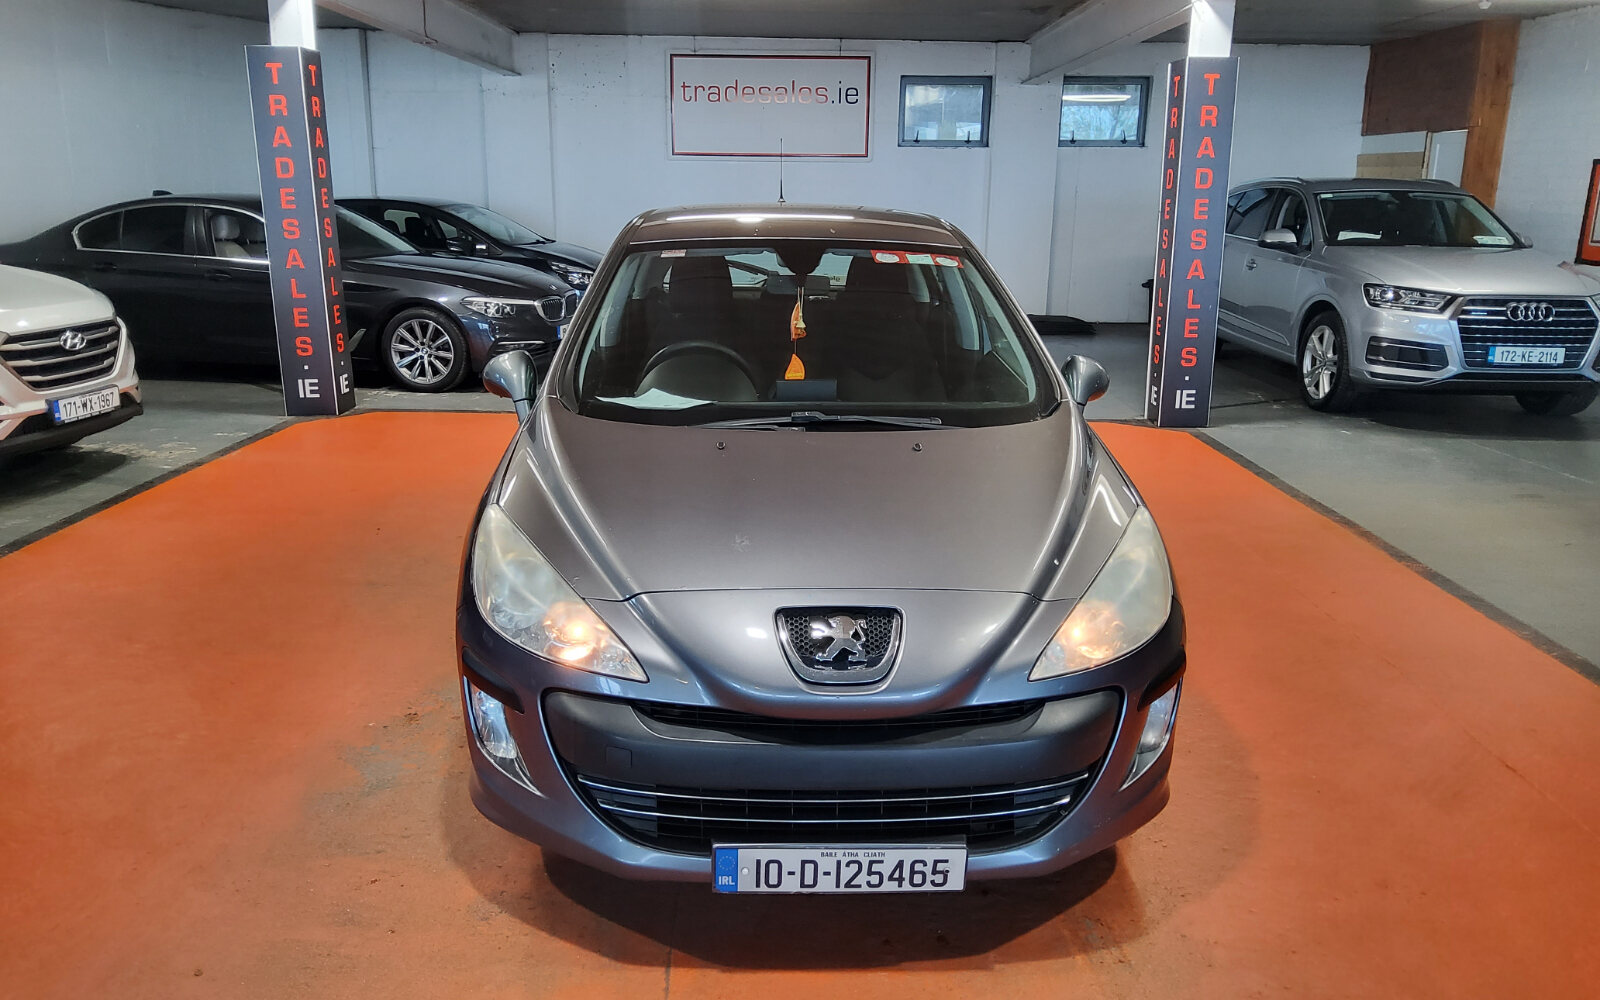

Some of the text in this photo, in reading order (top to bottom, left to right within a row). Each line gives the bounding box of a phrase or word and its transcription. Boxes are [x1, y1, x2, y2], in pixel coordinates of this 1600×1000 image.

[680, 79, 859, 104] tradesales.ie
[1500, 349, 1559, 363] 172-KE-2114
[63, 391, 114, 418] 171-WX-1967
[718, 875, 736, 886] IRL
[755, 858, 951, 889] 10-D-125465
